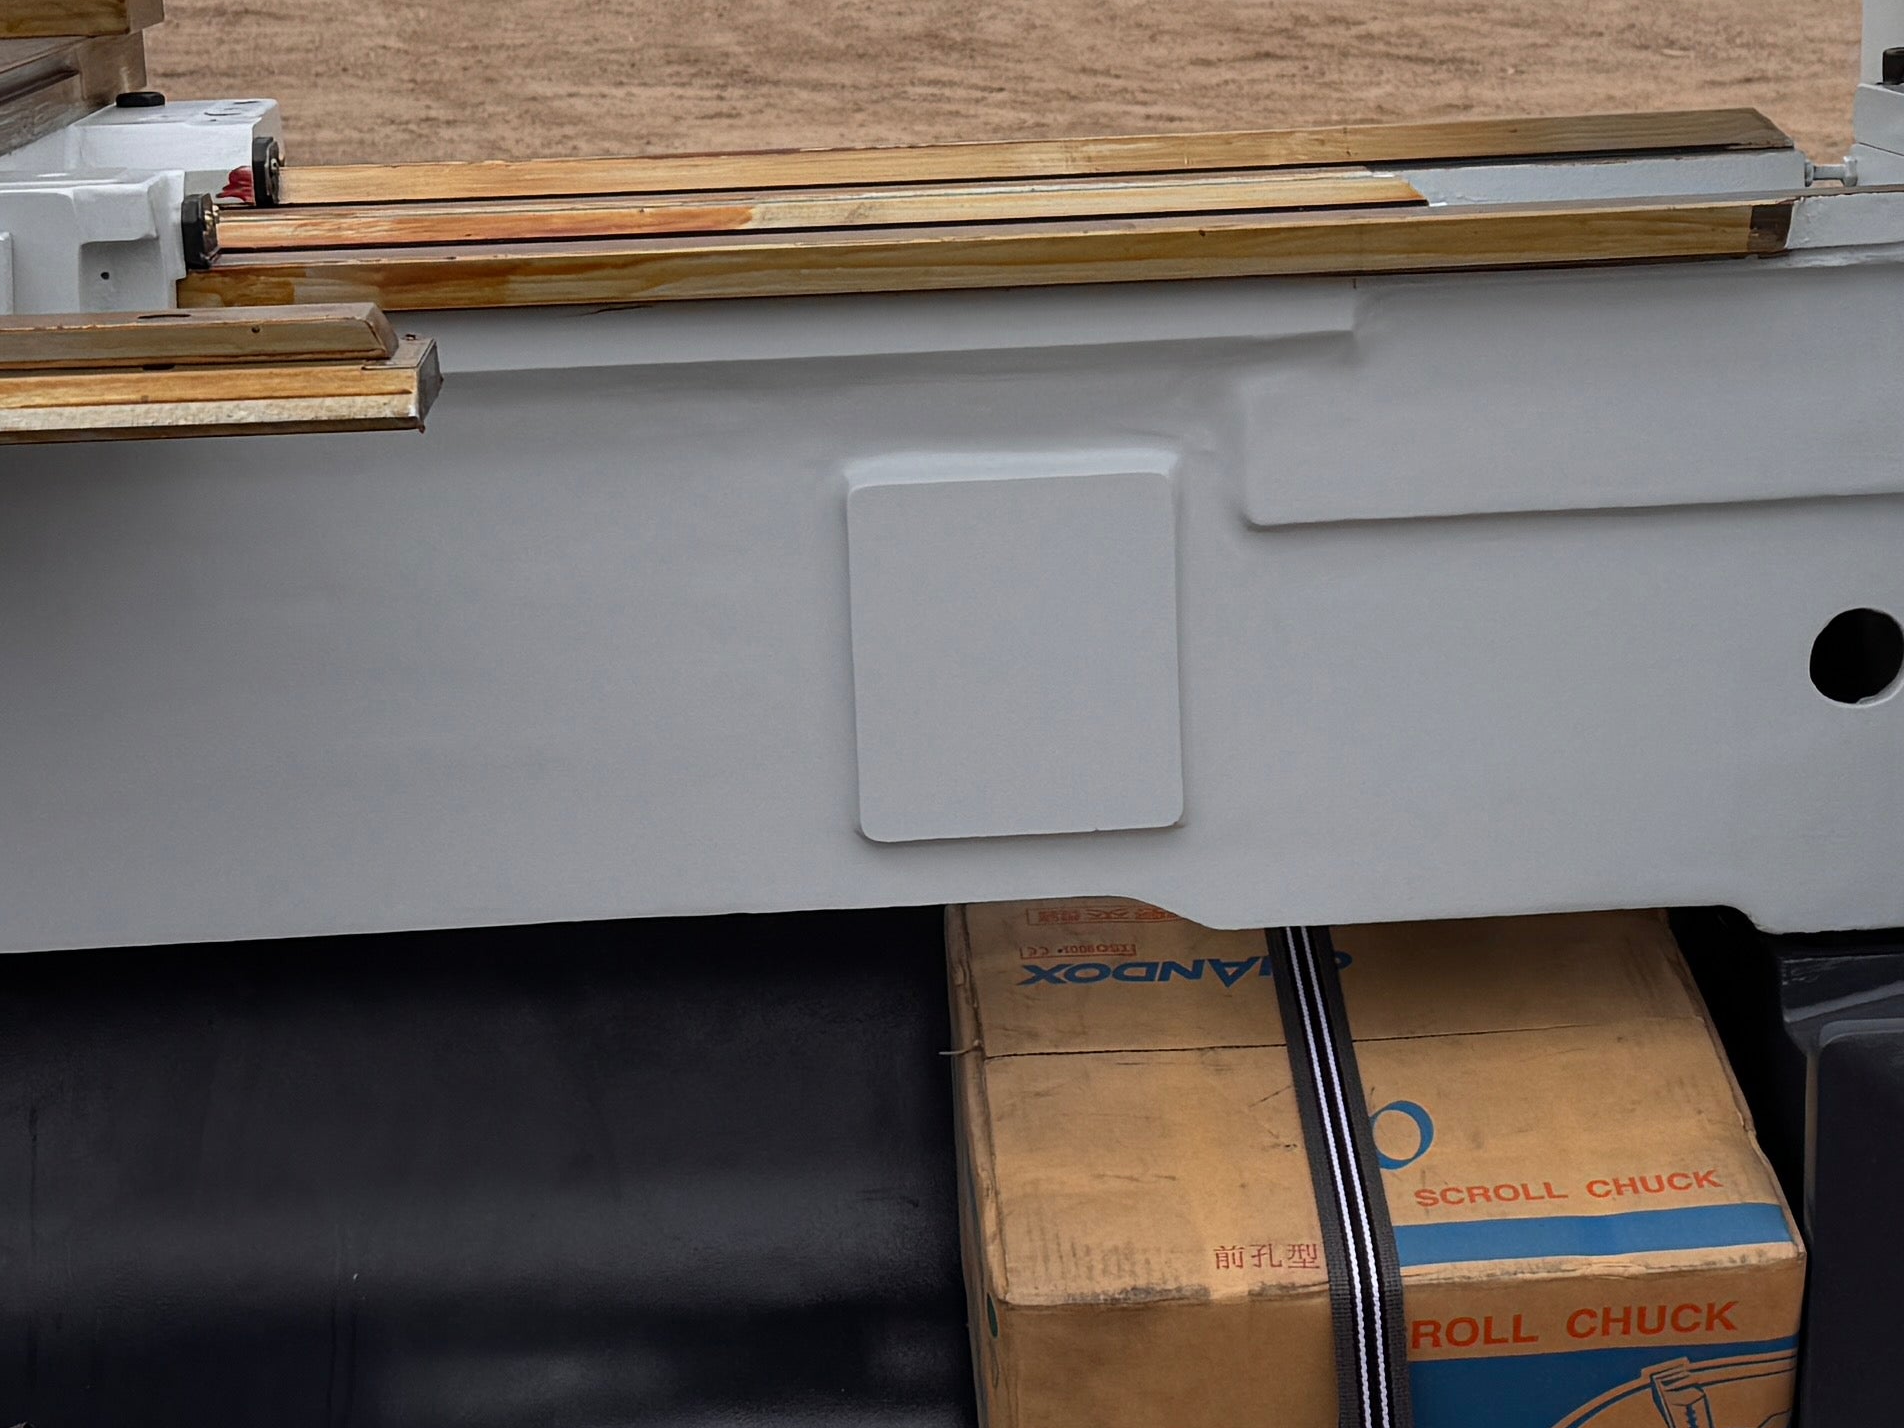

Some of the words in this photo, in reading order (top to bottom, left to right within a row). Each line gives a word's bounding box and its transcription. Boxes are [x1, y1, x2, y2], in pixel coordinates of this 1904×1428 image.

[1414, 1181, 1569, 1208] SCROLL
[1585, 1169, 1724, 1199] CHUCK
[1213, 1243, 1320, 1270] 前孔型
[1409, 1313, 1539, 1350] ROLL
[1566, 1301, 1741, 1339] CHUCK
